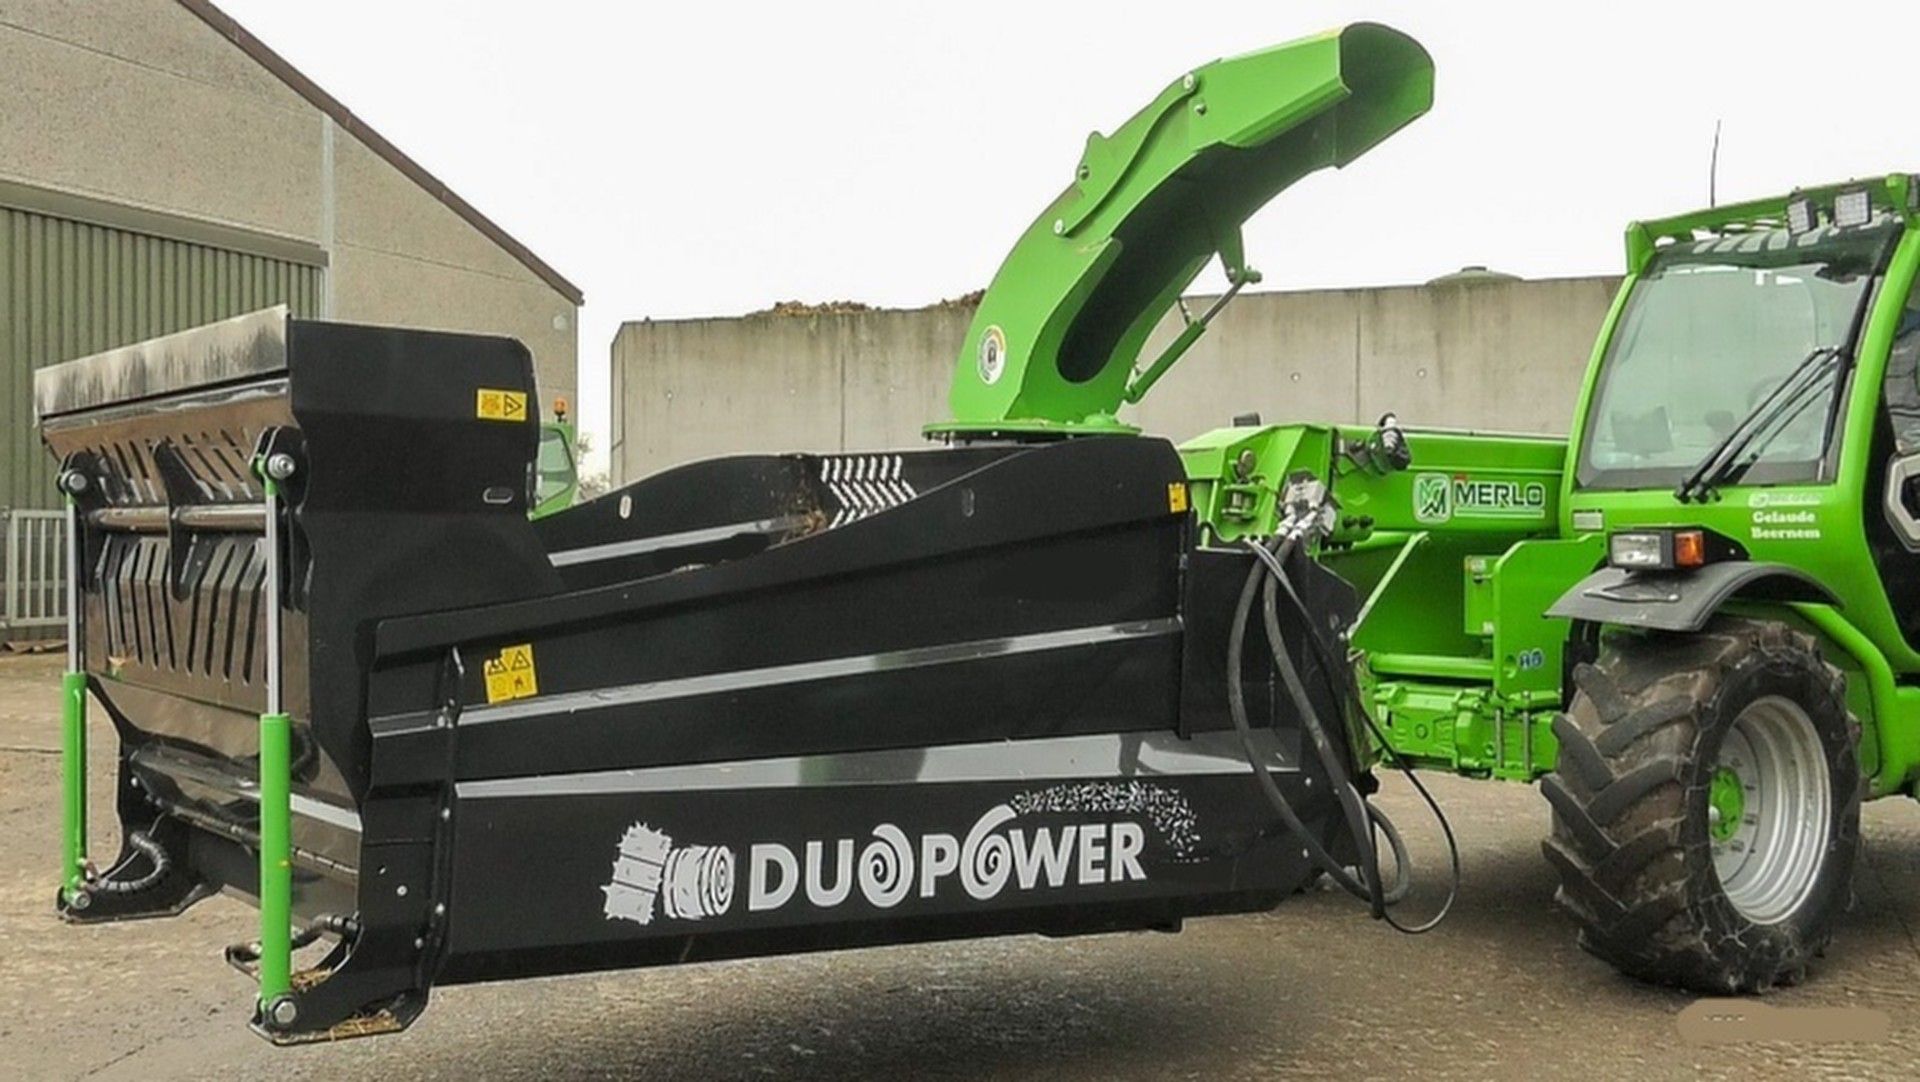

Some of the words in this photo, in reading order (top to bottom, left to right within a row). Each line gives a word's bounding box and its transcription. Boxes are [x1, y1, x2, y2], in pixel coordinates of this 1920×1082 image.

[1455, 482, 1545, 507] MERLO
[1752, 510, 1816, 524] Gelaude
[748, 804, 1147, 909] DUOPOWER
